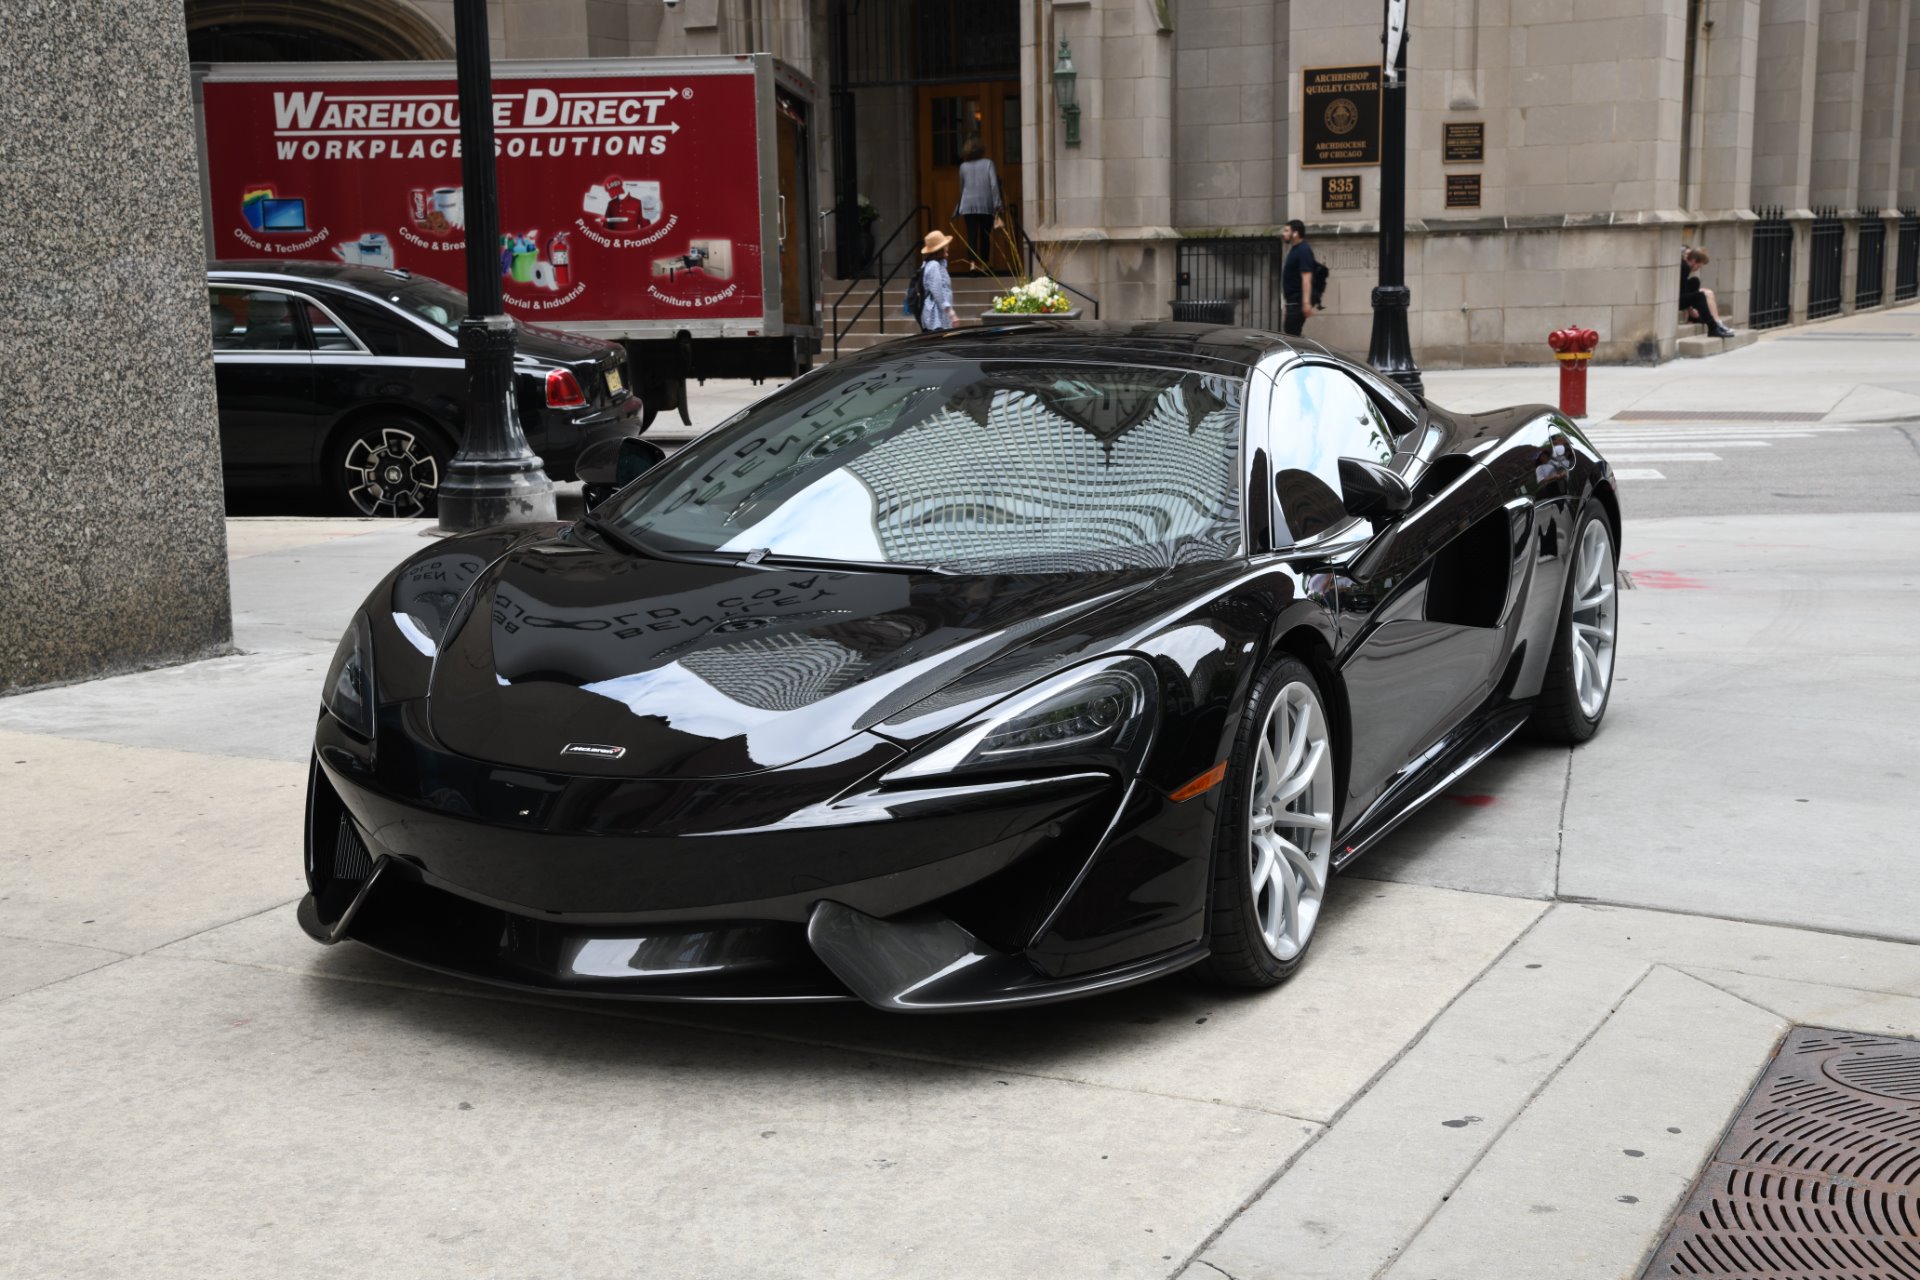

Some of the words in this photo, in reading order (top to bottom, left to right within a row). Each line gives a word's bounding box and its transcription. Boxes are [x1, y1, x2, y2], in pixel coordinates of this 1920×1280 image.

[1314, 71, 1369, 83] ARCHBISHOP
[1306, 84, 1342, 95] QUIGLEY
[1343, 82, 1378, 92] CENTER
[273, 92, 513, 129] WAREHOUE
[523, 88, 666, 126] DIRECT
[276, 139, 462, 160] WORKPLACE
[1315, 140, 1367, 150] ARCHDIOCESE
[1319, 151, 1329, 159] OF
[1330, 150, 1363, 159] CHICAGO
[1328, 178, 1354, 193] 835
[234, 228, 262, 249] Office
[264, 243, 273, 252] &
[274, 226, 330, 253] Technology
[399, 226, 429, 249] Coffee
[431, 241, 439, 251] &
[442, 241, 466, 251] Brea
[575, 218, 611, 248] Printing
[613, 239, 621, 248] &
[624, 214, 678, 248] Promotional
[533, 300, 541, 310] &
[543, 282, 586, 309] Industrial
[647, 284, 692, 307] Furniture
[694, 298, 702, 307] &
[704, 283, 737, 305] Design
